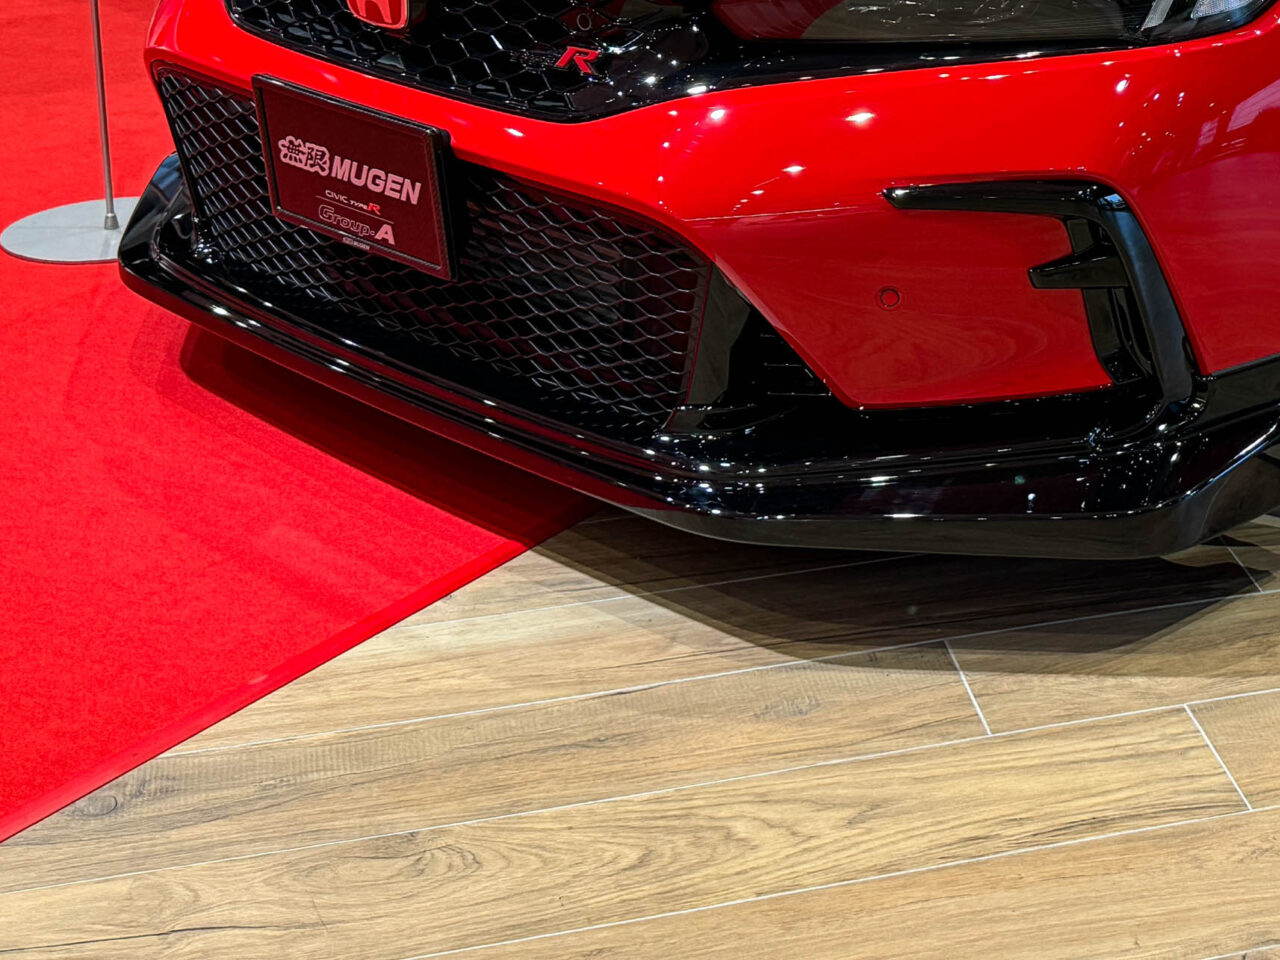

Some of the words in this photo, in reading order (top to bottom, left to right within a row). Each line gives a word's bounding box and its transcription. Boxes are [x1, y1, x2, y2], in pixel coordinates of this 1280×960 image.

[555, 45, 600, 75] R
[278, 135, 330, 177] 無限
[330, 155, 422, 205] MUGEN
[325, 189, 349, 204] CIVIC
[349, 199, 368, 211] TYPE
[367, 202, 381, 216] R
[318, 204, 396, 246] Group.A
